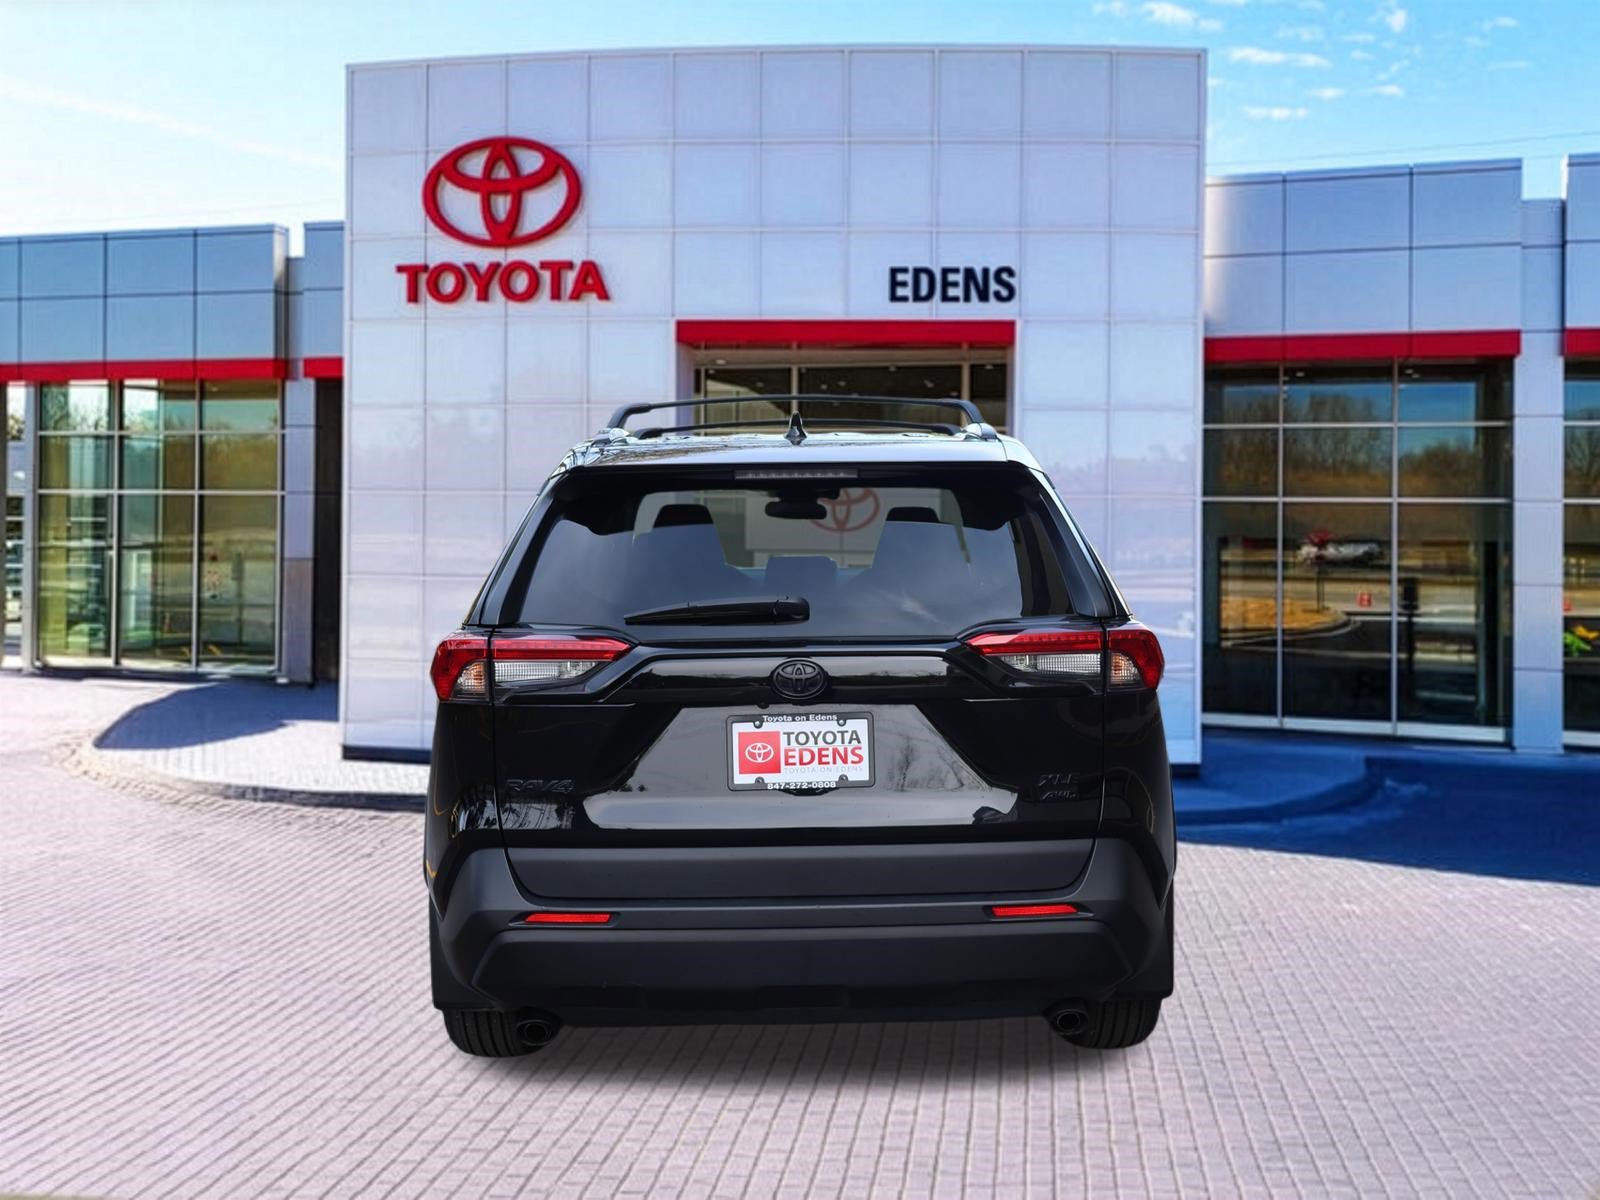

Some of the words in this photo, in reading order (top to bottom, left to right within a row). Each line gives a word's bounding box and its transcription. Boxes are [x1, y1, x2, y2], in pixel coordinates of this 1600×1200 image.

[396, 261, 609, 303] TOYOTA
[889, 265, 1016, 303] EDENS
[762, 714, 793, 723] Toyota
[809, 713, 838, 721] Edens
[783, 730, 862, 746] TOYOTA
[784, 746, 864, 767] EDENS
[784, 766, 818, 774] TOYOTA
[835, 765, 863, 773] EDENS
[767, 781, 837, 790] 847-272-0808
